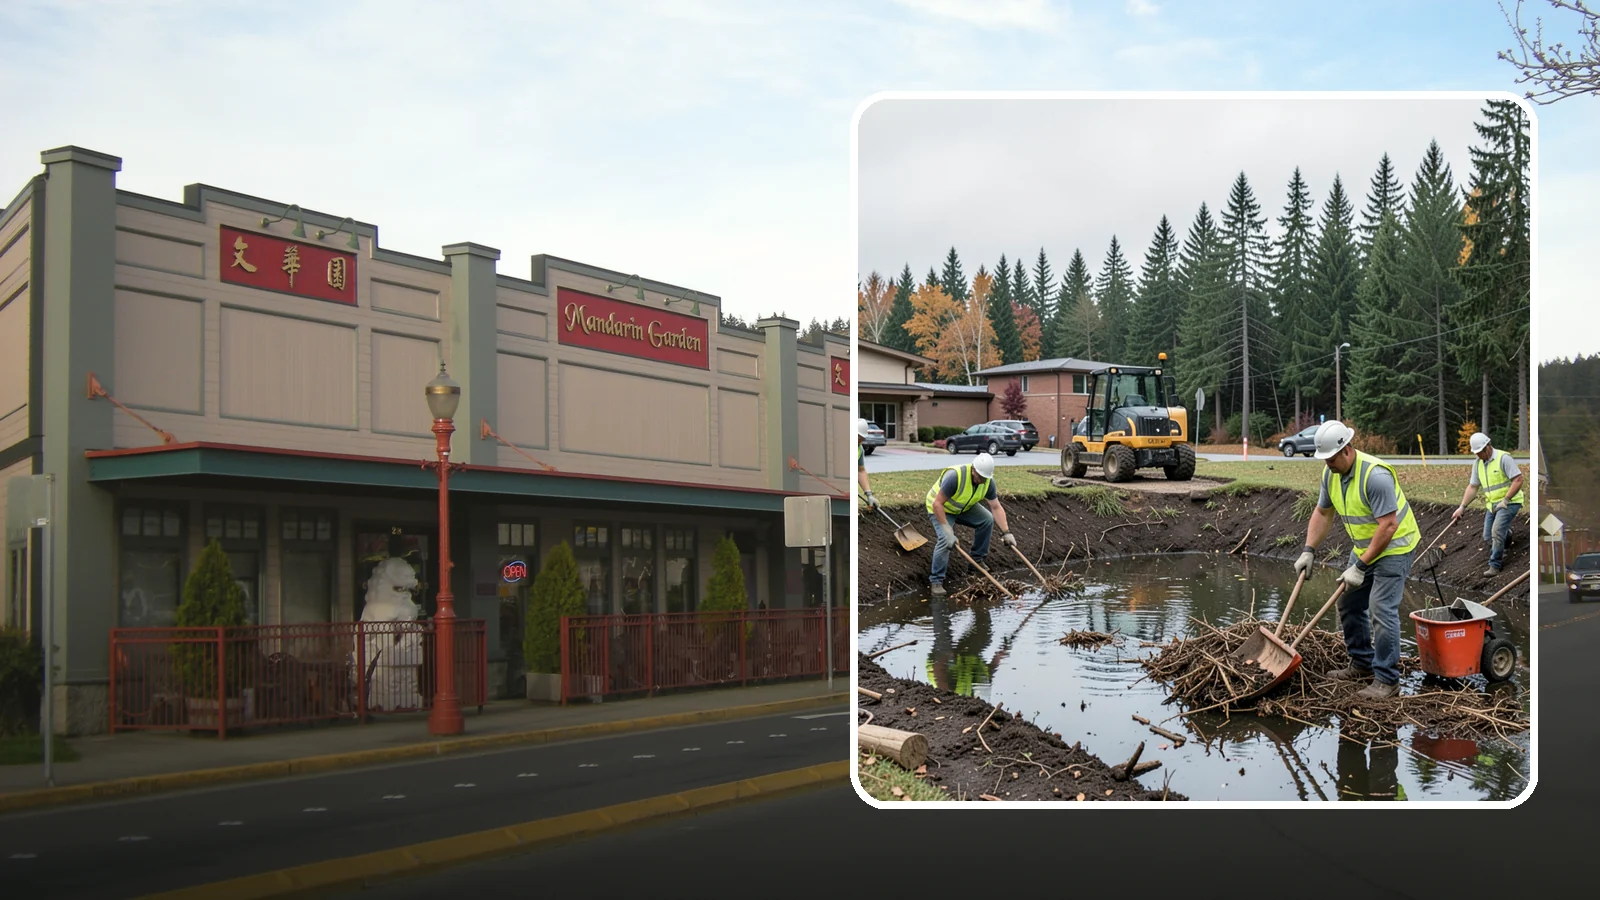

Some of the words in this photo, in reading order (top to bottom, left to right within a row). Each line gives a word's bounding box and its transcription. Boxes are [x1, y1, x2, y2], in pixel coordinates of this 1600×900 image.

[230, 236, 346, 291] 文華園
[564, 302, 644, 342] Mandarin
[648, 320, 701, 352] Garden
[503, 565, 527, 578] OPEN
